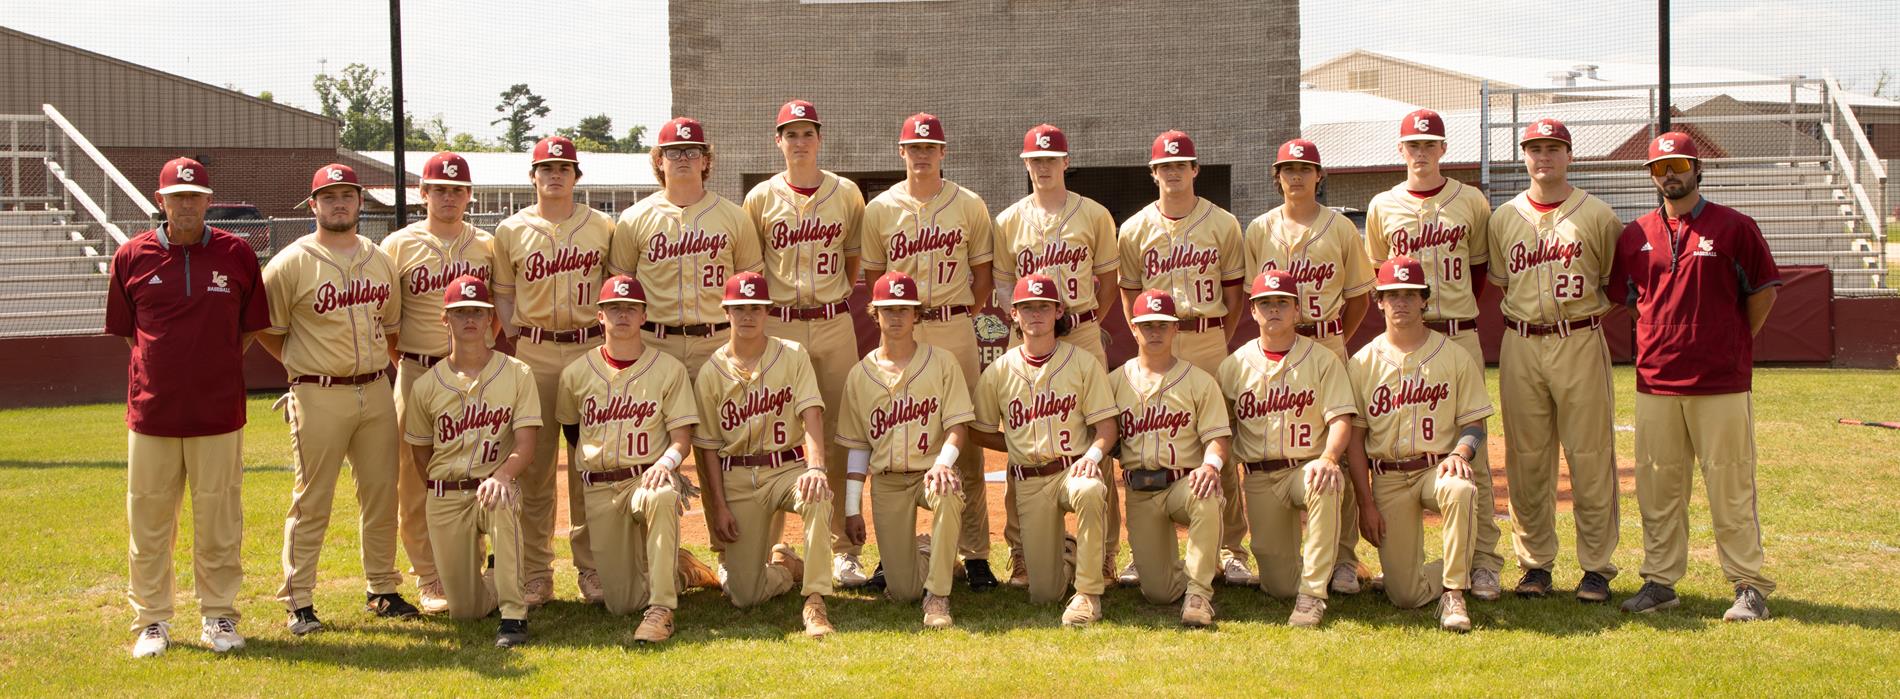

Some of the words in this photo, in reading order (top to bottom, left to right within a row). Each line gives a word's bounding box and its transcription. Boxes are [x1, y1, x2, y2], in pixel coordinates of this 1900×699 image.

[648, 229, 728, 263] Bulldogs
[771, 216, 843, 250] Bulldogs
[889, 225, 963, 262] Bulldogs
[1391, 221, 1466, 257] Bulldogs
[525, 247, 600, 282] Bulldogs
[817, 252, 838, 275] 20
[1017, 242, 1089, 278] Bulldogs
[1143, 243, 1218, 280] Bulldogs
[1443, 258, 1462, 282] 18
[1509, 238, 1583, 274] Bulldogs
[702, 265, 725, 288] 28
[938, 261, 958, 284] 17
[1262, 260, 1335, 292] lldogs
[1555, 274, 1585, 299] 23
[313, 280, 390, 315] Bulldogs
[577, 282, 591, 306] 11
[1066, 278, 1078, 300] 9
[1194, 279, 1214, 303] 13
[1309, 296, 1321, 318] 5
[583, 394, 657, 428] Bulldogs
[721, 386, 793, 432] Bulldogs
[1008, 390, 1077, 430] Bulldogs
[1238, 385, 1315, 421] Bulldogs
[1369, 376, 1449, 418] Bulldogs
[438, 402, 512, 444] Bulldogs
[773, 421, 786, 445] 6
[1120, 405, 1192, 441] Bulldogs
[1289, 423, 1312, 448] 12
[1422, 417, 1434, 442] 8
[481, 441, 500, 465] 16
[627, 431, 649, 457] 10
[917, 432, 929, 455] 4
[1059, 430, 1072, 452] 2
[1167, 443, 1176, 465] 1
